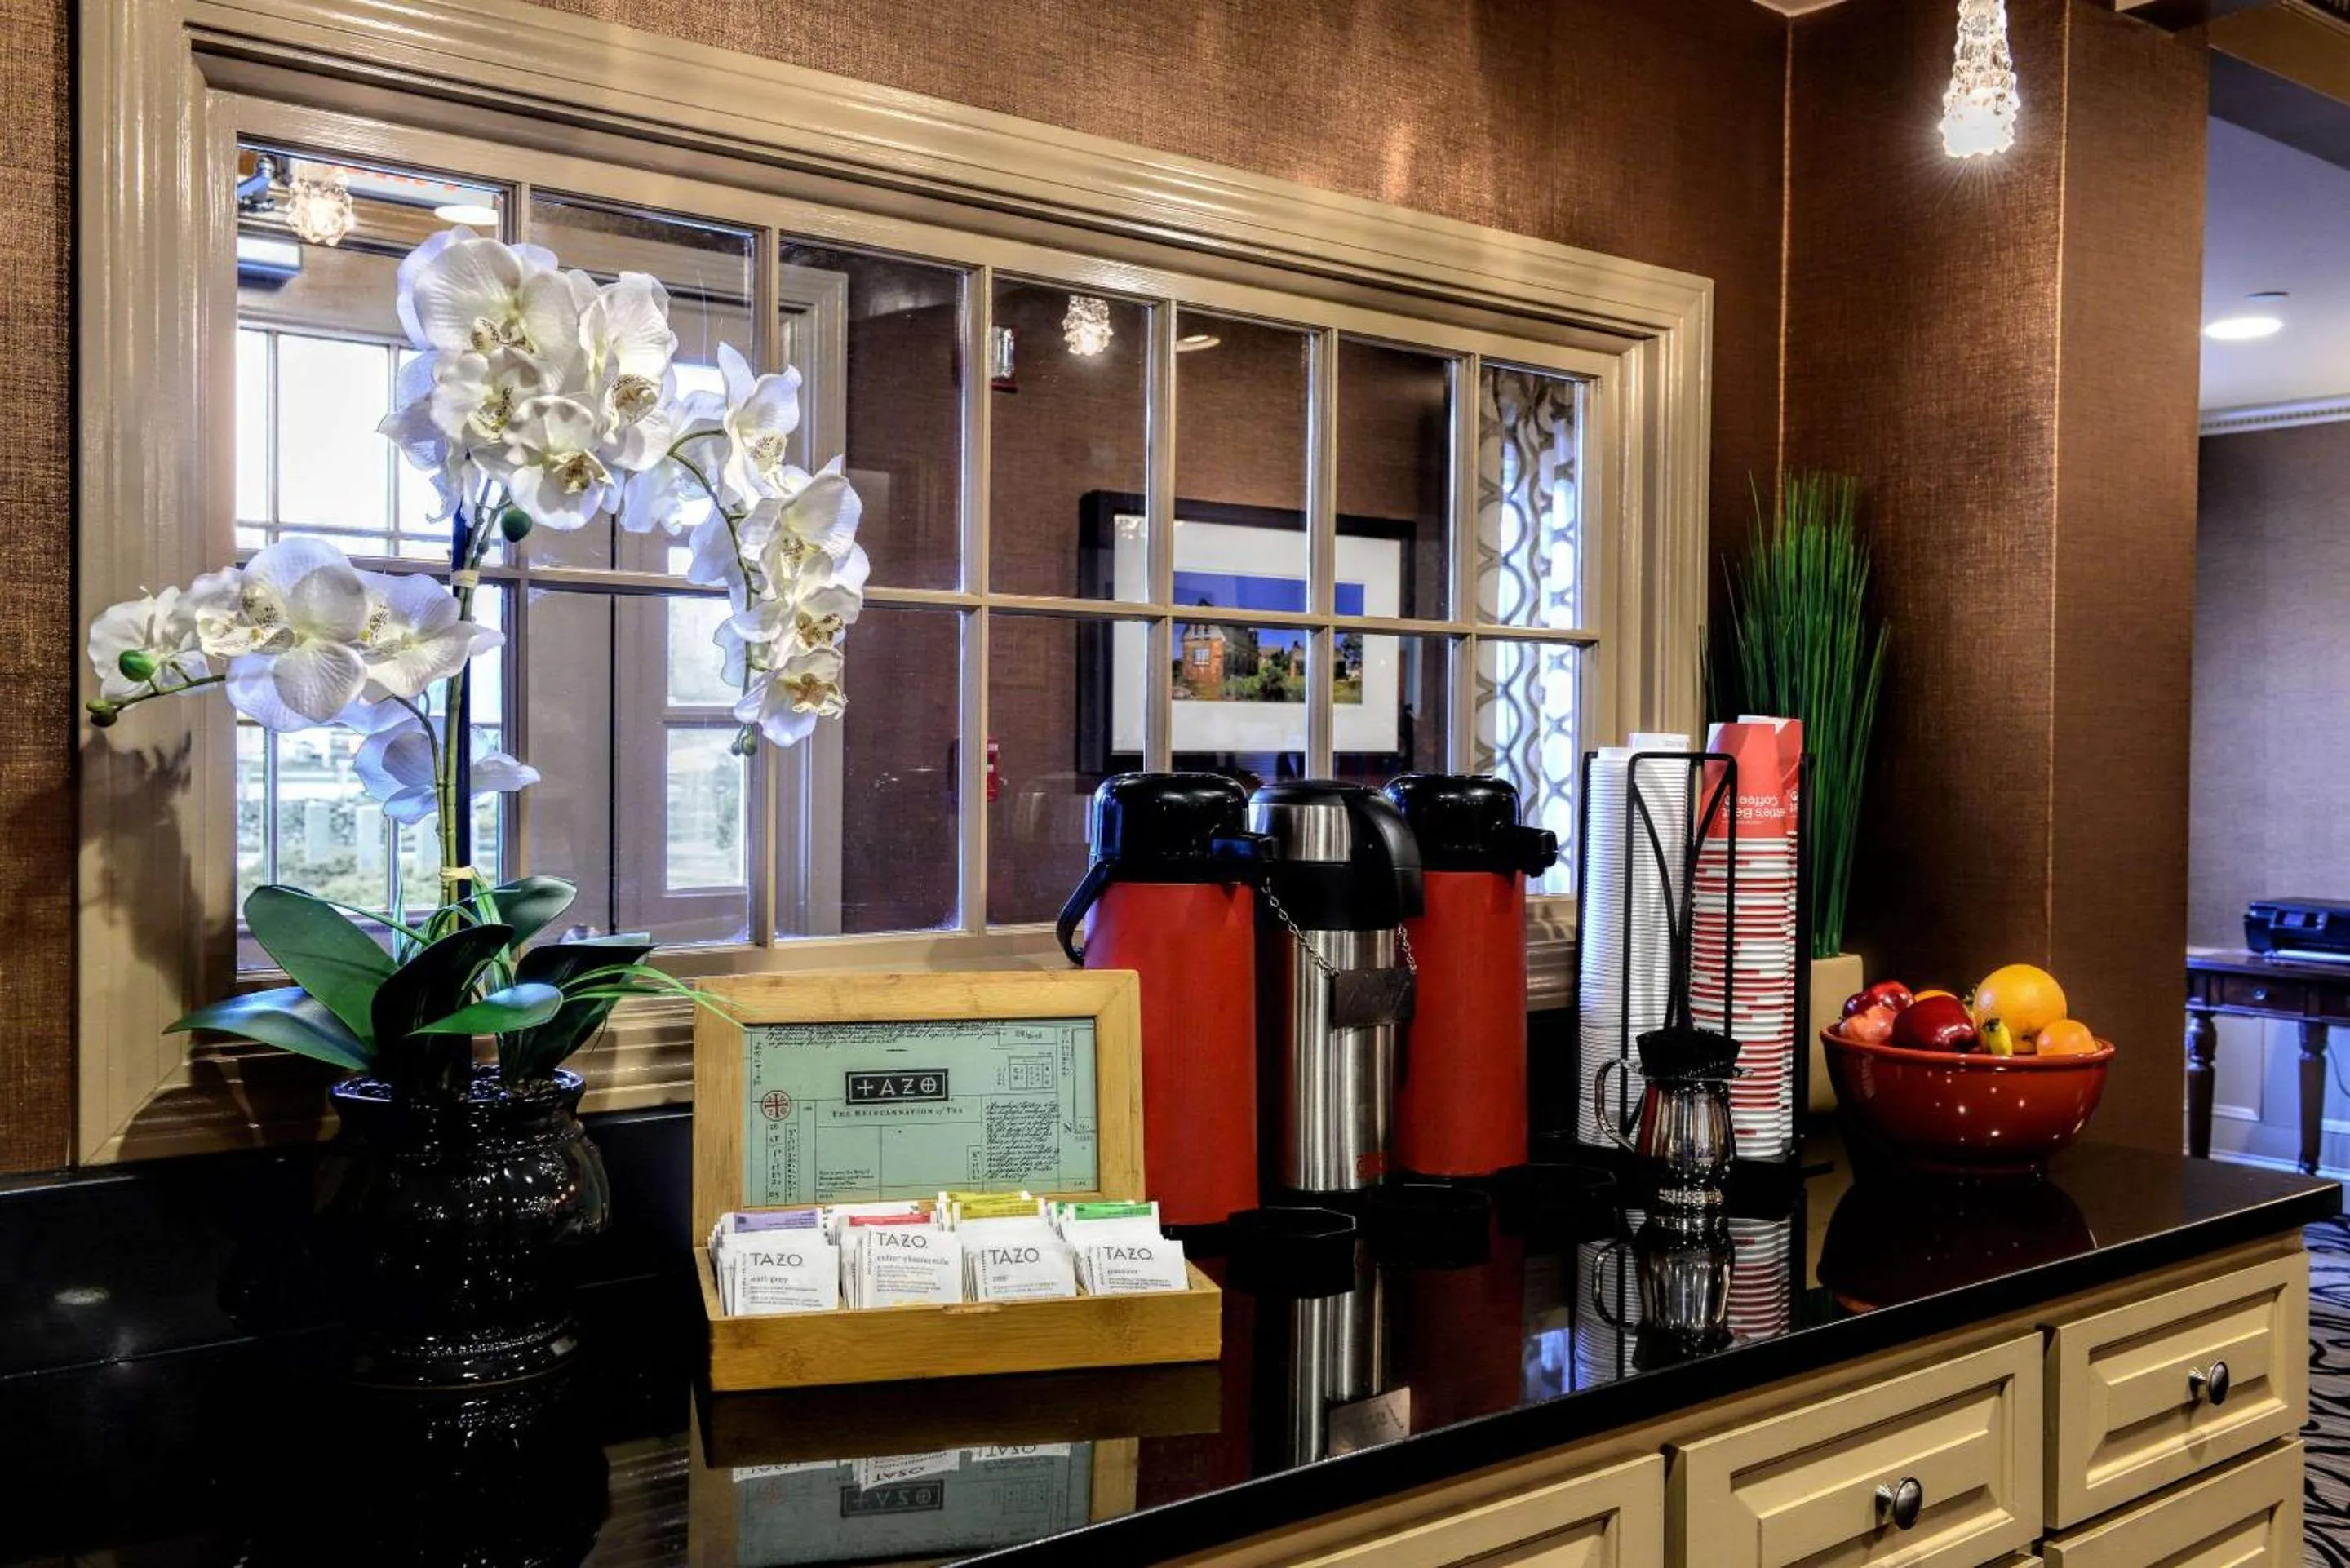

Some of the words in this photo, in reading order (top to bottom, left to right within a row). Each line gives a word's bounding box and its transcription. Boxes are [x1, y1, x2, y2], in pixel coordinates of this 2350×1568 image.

[1739, 796, 1778, 807] Coffee
[1722, 808, 1753, 818] Bet
[876, 1232, 927, 1248] TAZO
[749, 1252, 803, 1267] TAZO
[988, 1247, 1040, 1265] TAZO
[1103, 1247, 1151, 1260] TAZO
